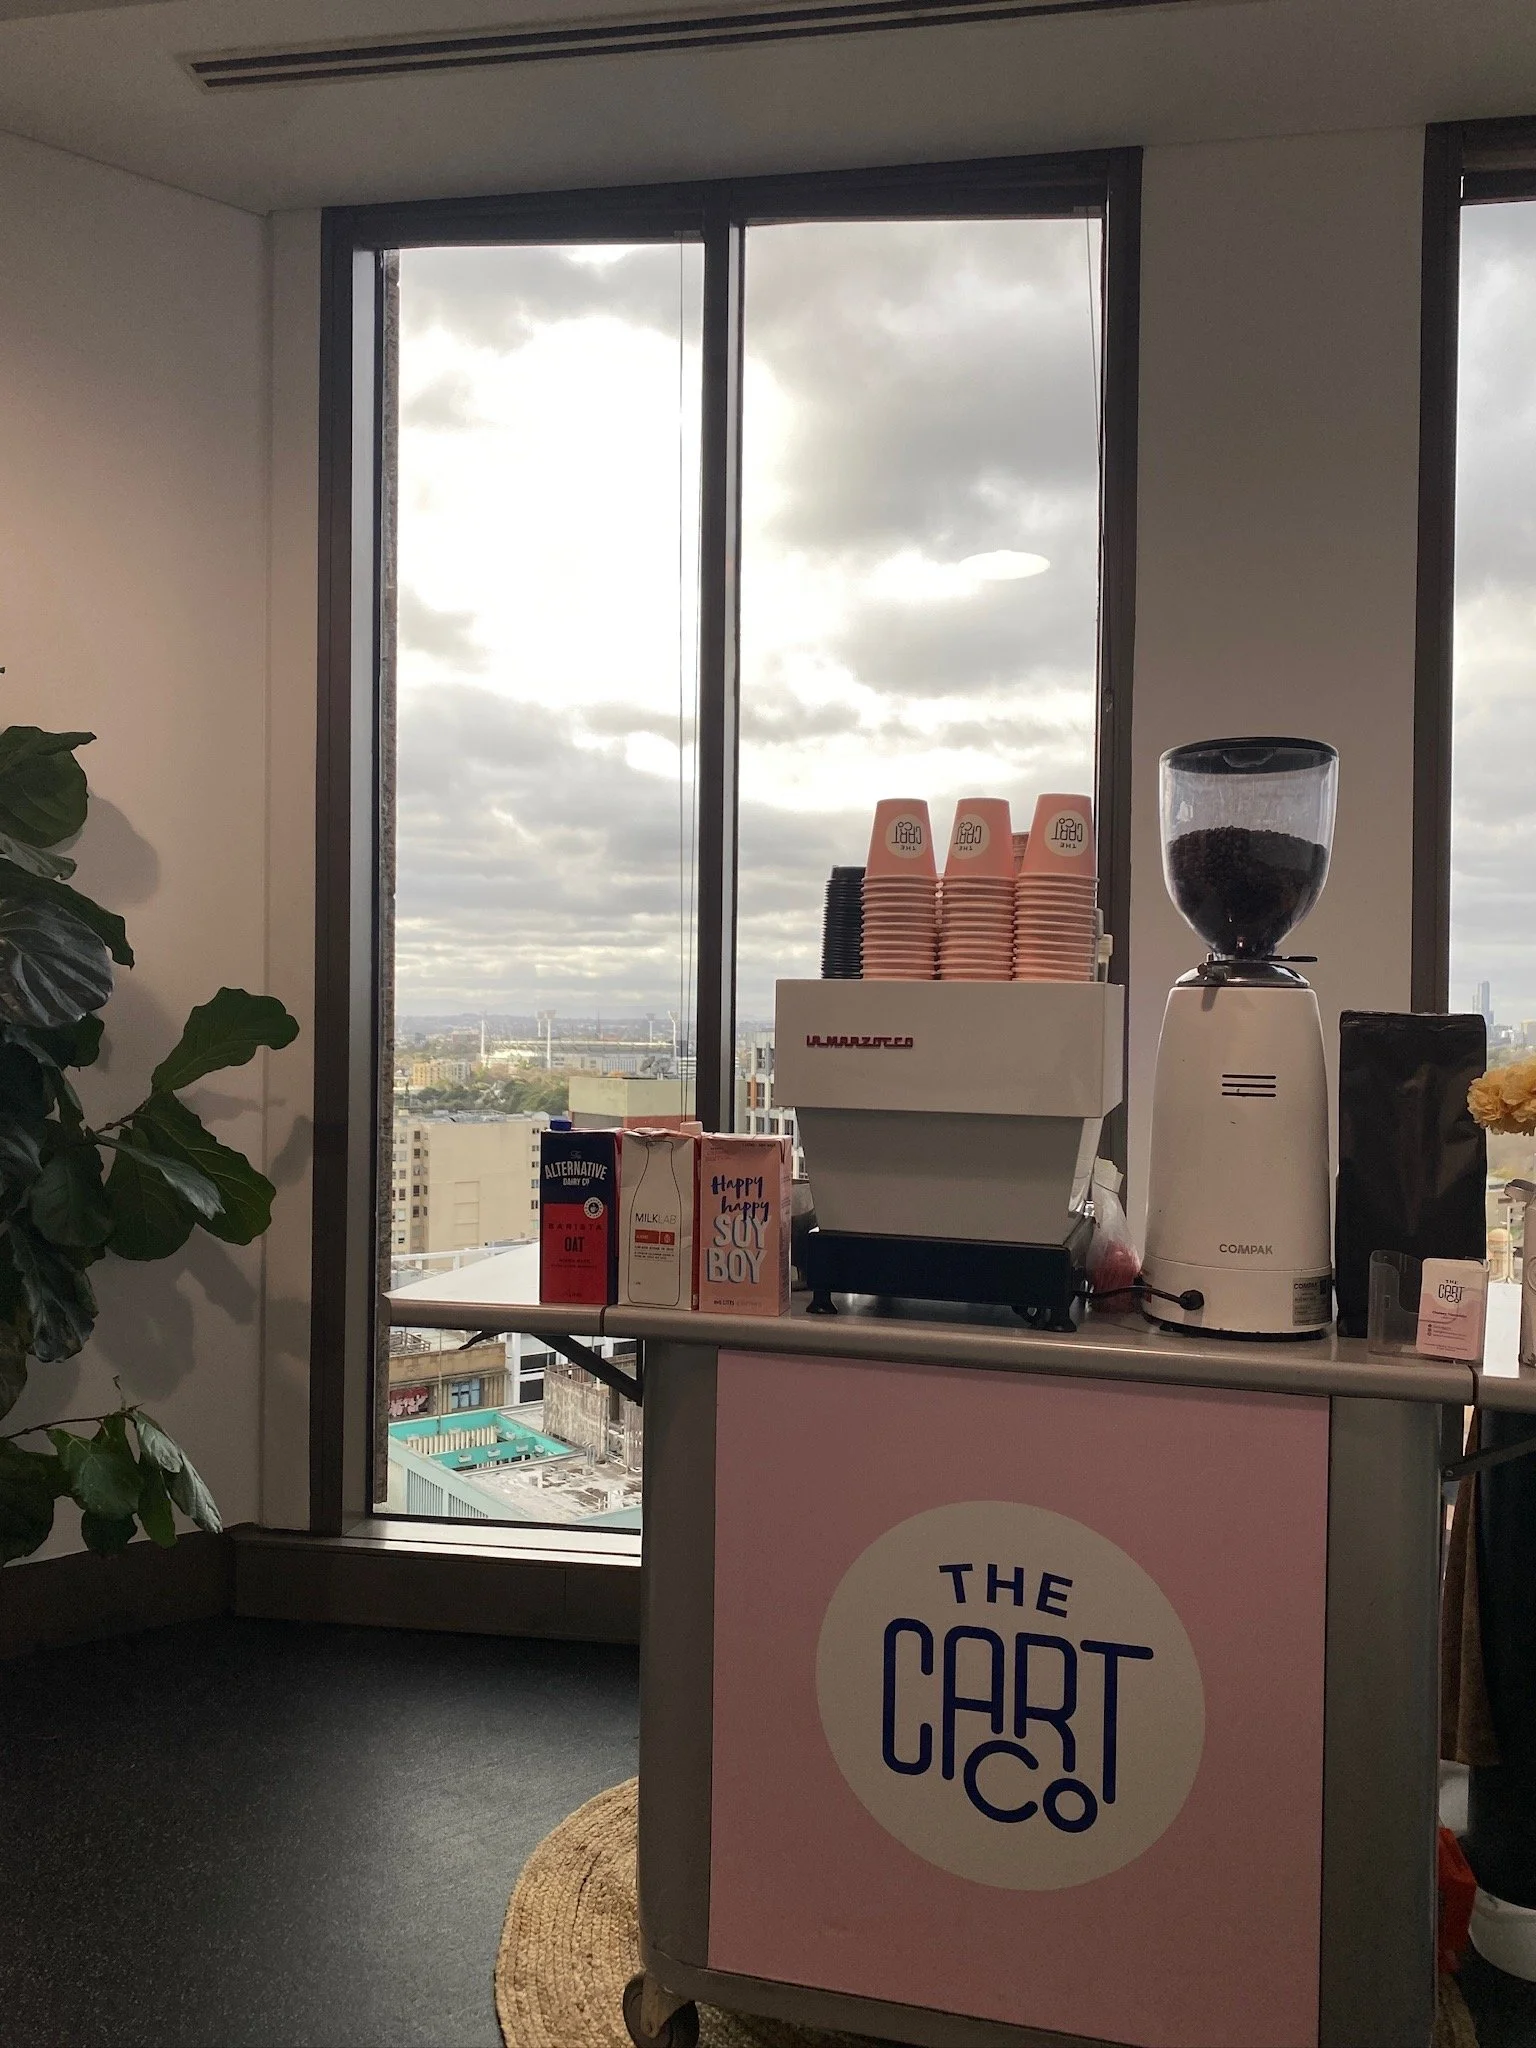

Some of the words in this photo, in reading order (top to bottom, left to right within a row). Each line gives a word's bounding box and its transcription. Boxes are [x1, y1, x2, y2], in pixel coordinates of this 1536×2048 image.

[891, 825, 922, 844] CART
[953, 825, 982, 845] CART
[1050, 821, 1083, 843] CART
[544, 1160, 608, 1180] ALTERNATIVE
[562, 1177, 581, 1186] DAIRY
[711, 1174, 763, 1199] Happy
[721, 1195, 770, 1222] happy
[547, 1222, 602, 1231] BARISTA
[712, 1214, 771, 1250] SOY
[564, 1236, 585, 1252] OAT
[1219, 1243, 1273, 1255] COMPAK
[704, 1247, 768, 1285] BOY
[1438, 1283, 1465, 1301] CART
[938, 1562, 1074, 1619] THE
[881, 1617, 1155, 1805] CART
